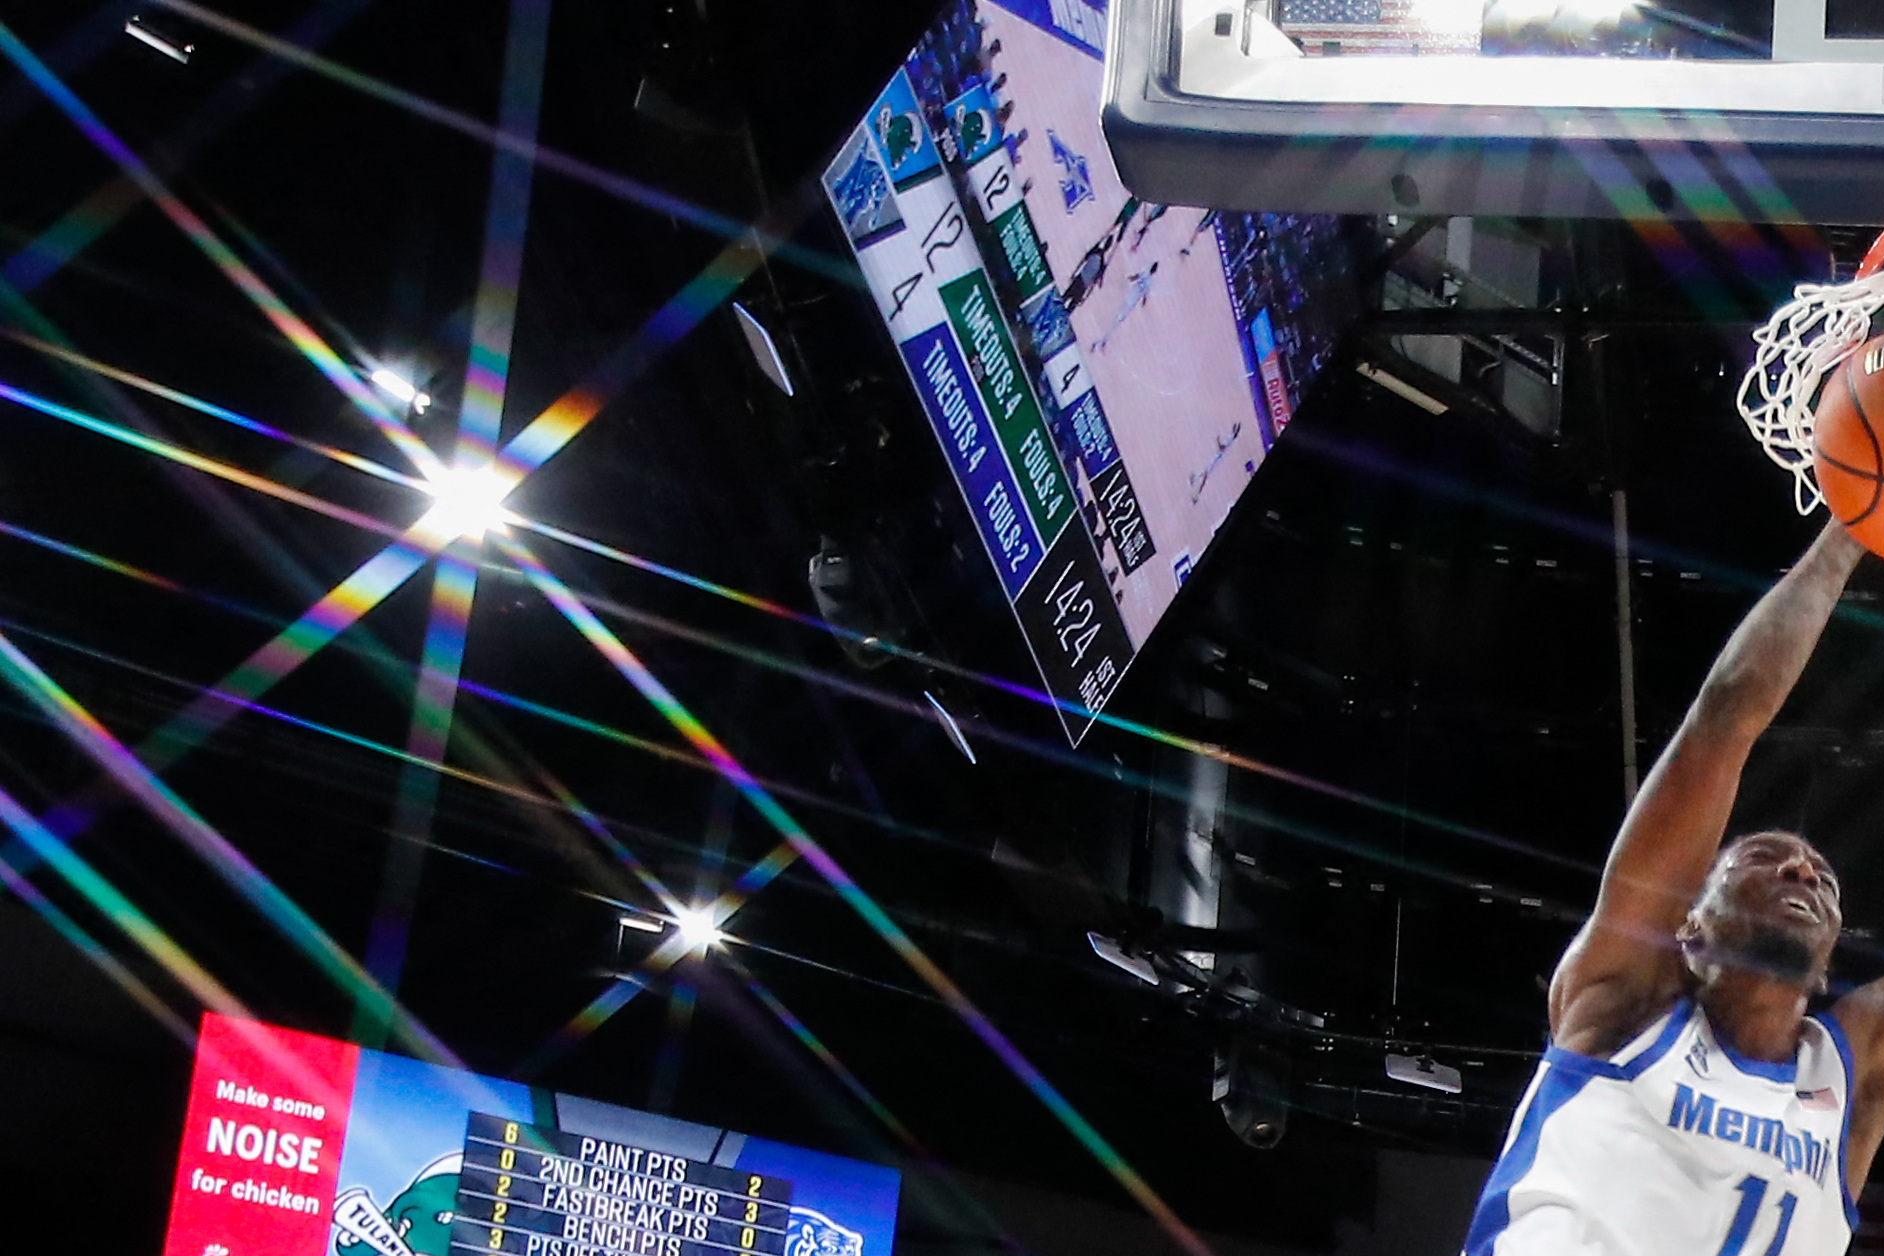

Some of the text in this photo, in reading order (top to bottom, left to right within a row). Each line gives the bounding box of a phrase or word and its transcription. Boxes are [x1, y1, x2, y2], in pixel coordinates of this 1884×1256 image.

[921, 202, 968, 274] 12
[889, 272, 924, 322] 4
[960, 284, 1014, 406] TIMEOUTS:
[1005, 392, 1024, 421] 4
[1019, 427, 1056, 507] FOULS:
[1047, 493, 1065, 520] 4
[1061, 363, 1080, 394] 4
[922, 338, 978, 460] TIMEOUTS:
[967, 445, 988, 473] 4
[983, 481, 1022, 559] FOULS:
[1010, 542, 1031, 575] 2
[1099, 467, 1140, 550] 14:24
[1044, 560, 1102, 669] 14:24
[215, 1079, 326, 1121] Make some
[205, 1117, 324, 1175] NOISE
[504, 1122, 763, 1198] 6 PAINT PTS 2
[191, 1168, 320, 1216] for chicken
[497, 1174, 755, 1249] 2 FASTBREAK PTS 0
[501, 1149, 759, 1224] 0 2ND CHANCE PTS 3
[489, 1228, 503, 1250] 3
[493, 1202, 507, 1224] 2
[563, 1216, 638, 1252] BENCH
